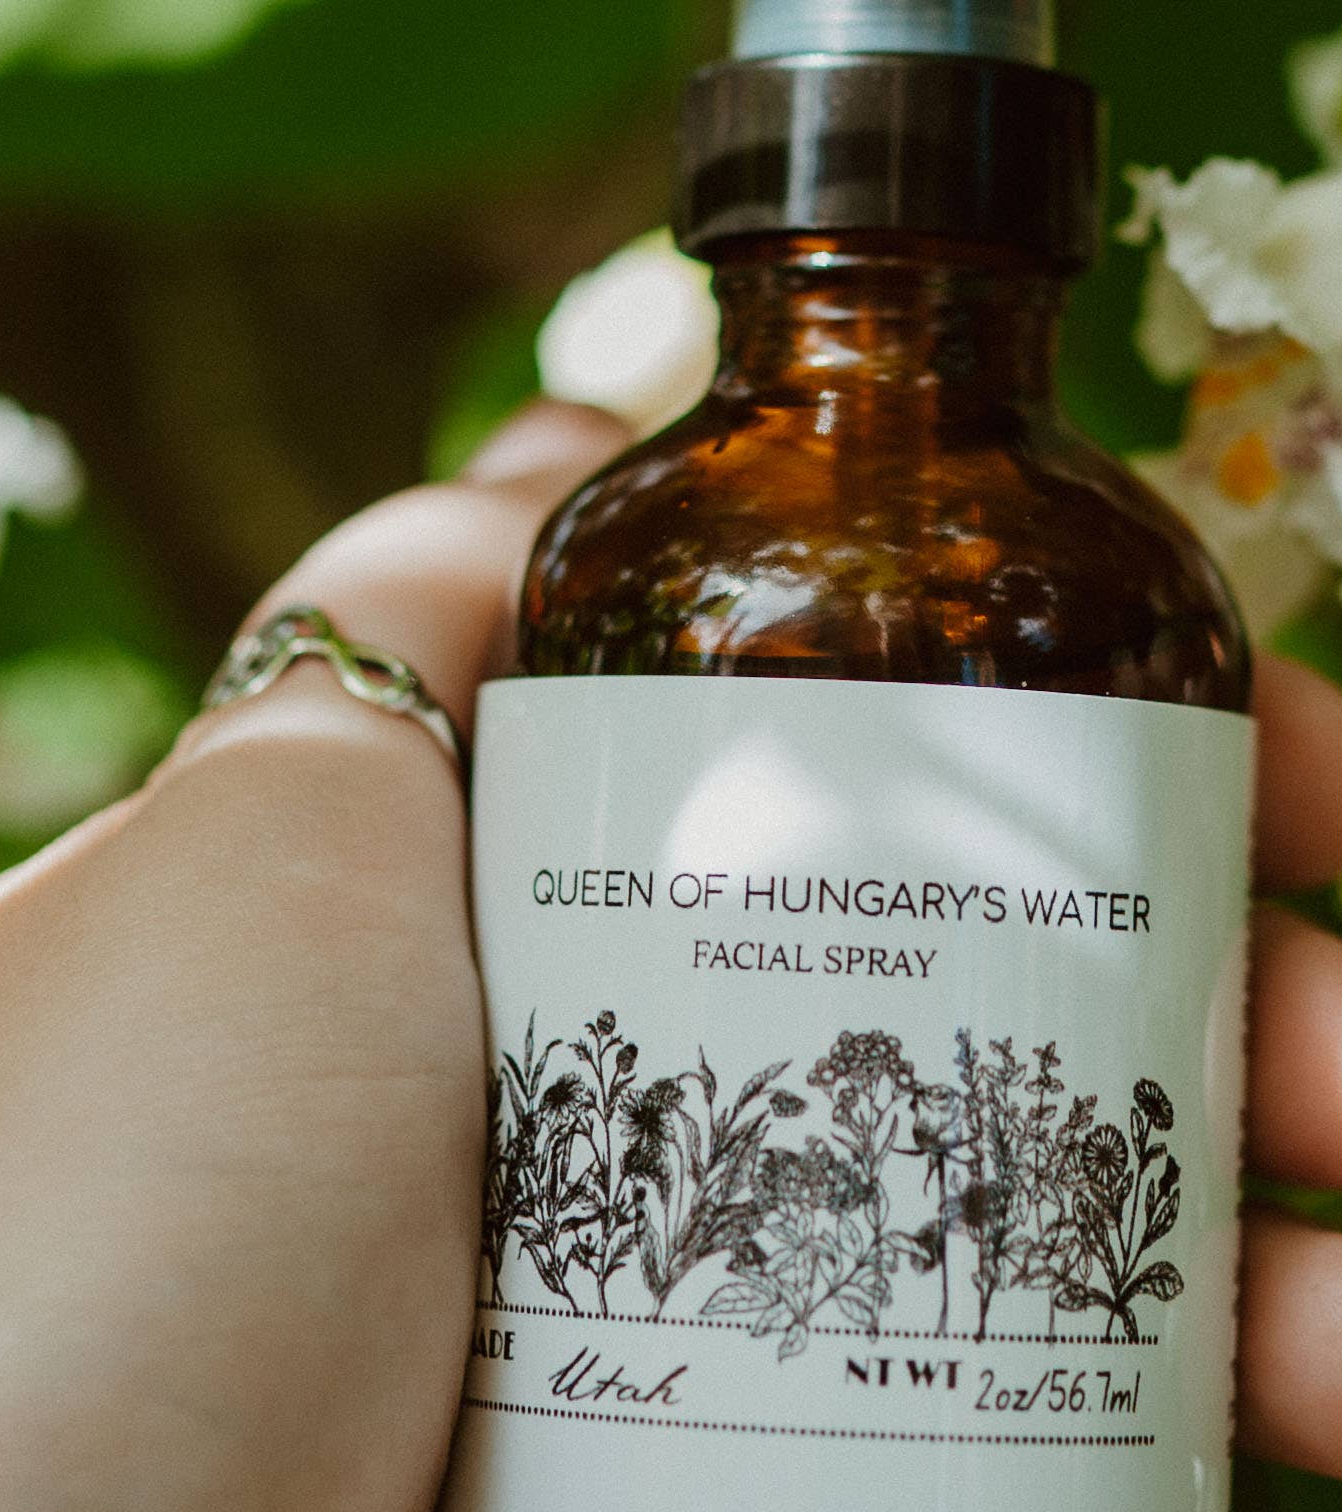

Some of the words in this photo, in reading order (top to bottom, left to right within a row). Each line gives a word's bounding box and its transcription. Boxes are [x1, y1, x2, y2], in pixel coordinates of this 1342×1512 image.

[532, 869, 654, 908] QUEEN
[669, 873, 727, 909] OF
[744, 876, 1007, 924] HUNGARY'S
[1022, 887, 1151, 933] WATER
[693, 940, 813, 973] FACIAL
[823, 947, 937, 979] SPRAY
[471, 1329, 515, 1361] ADE
[548, 1346, 688, 1405] Utah
[845, 1357, 894, 1387] NT
[905, 1358, 963, 1390] WT
